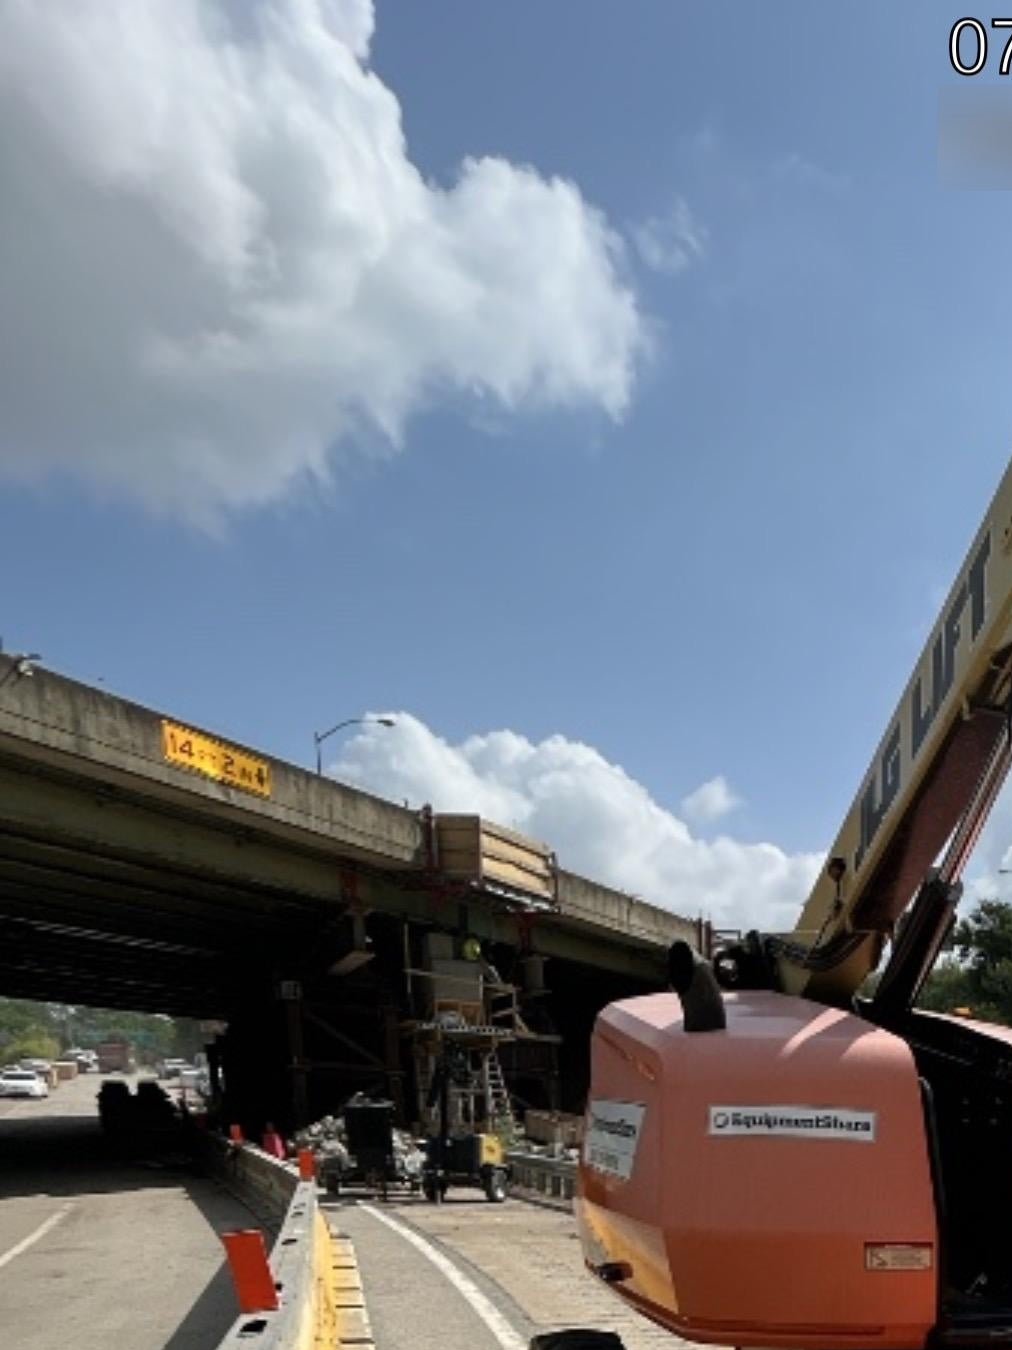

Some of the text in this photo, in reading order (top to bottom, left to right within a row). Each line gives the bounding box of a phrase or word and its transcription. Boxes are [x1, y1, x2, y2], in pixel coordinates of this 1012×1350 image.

[911, 531, 991, 759] LIFT
[169, 732, 195, 757] 14
[221, 752, 236, 777] 2
[731, 1112, 871, 1132] EquipmentShare
